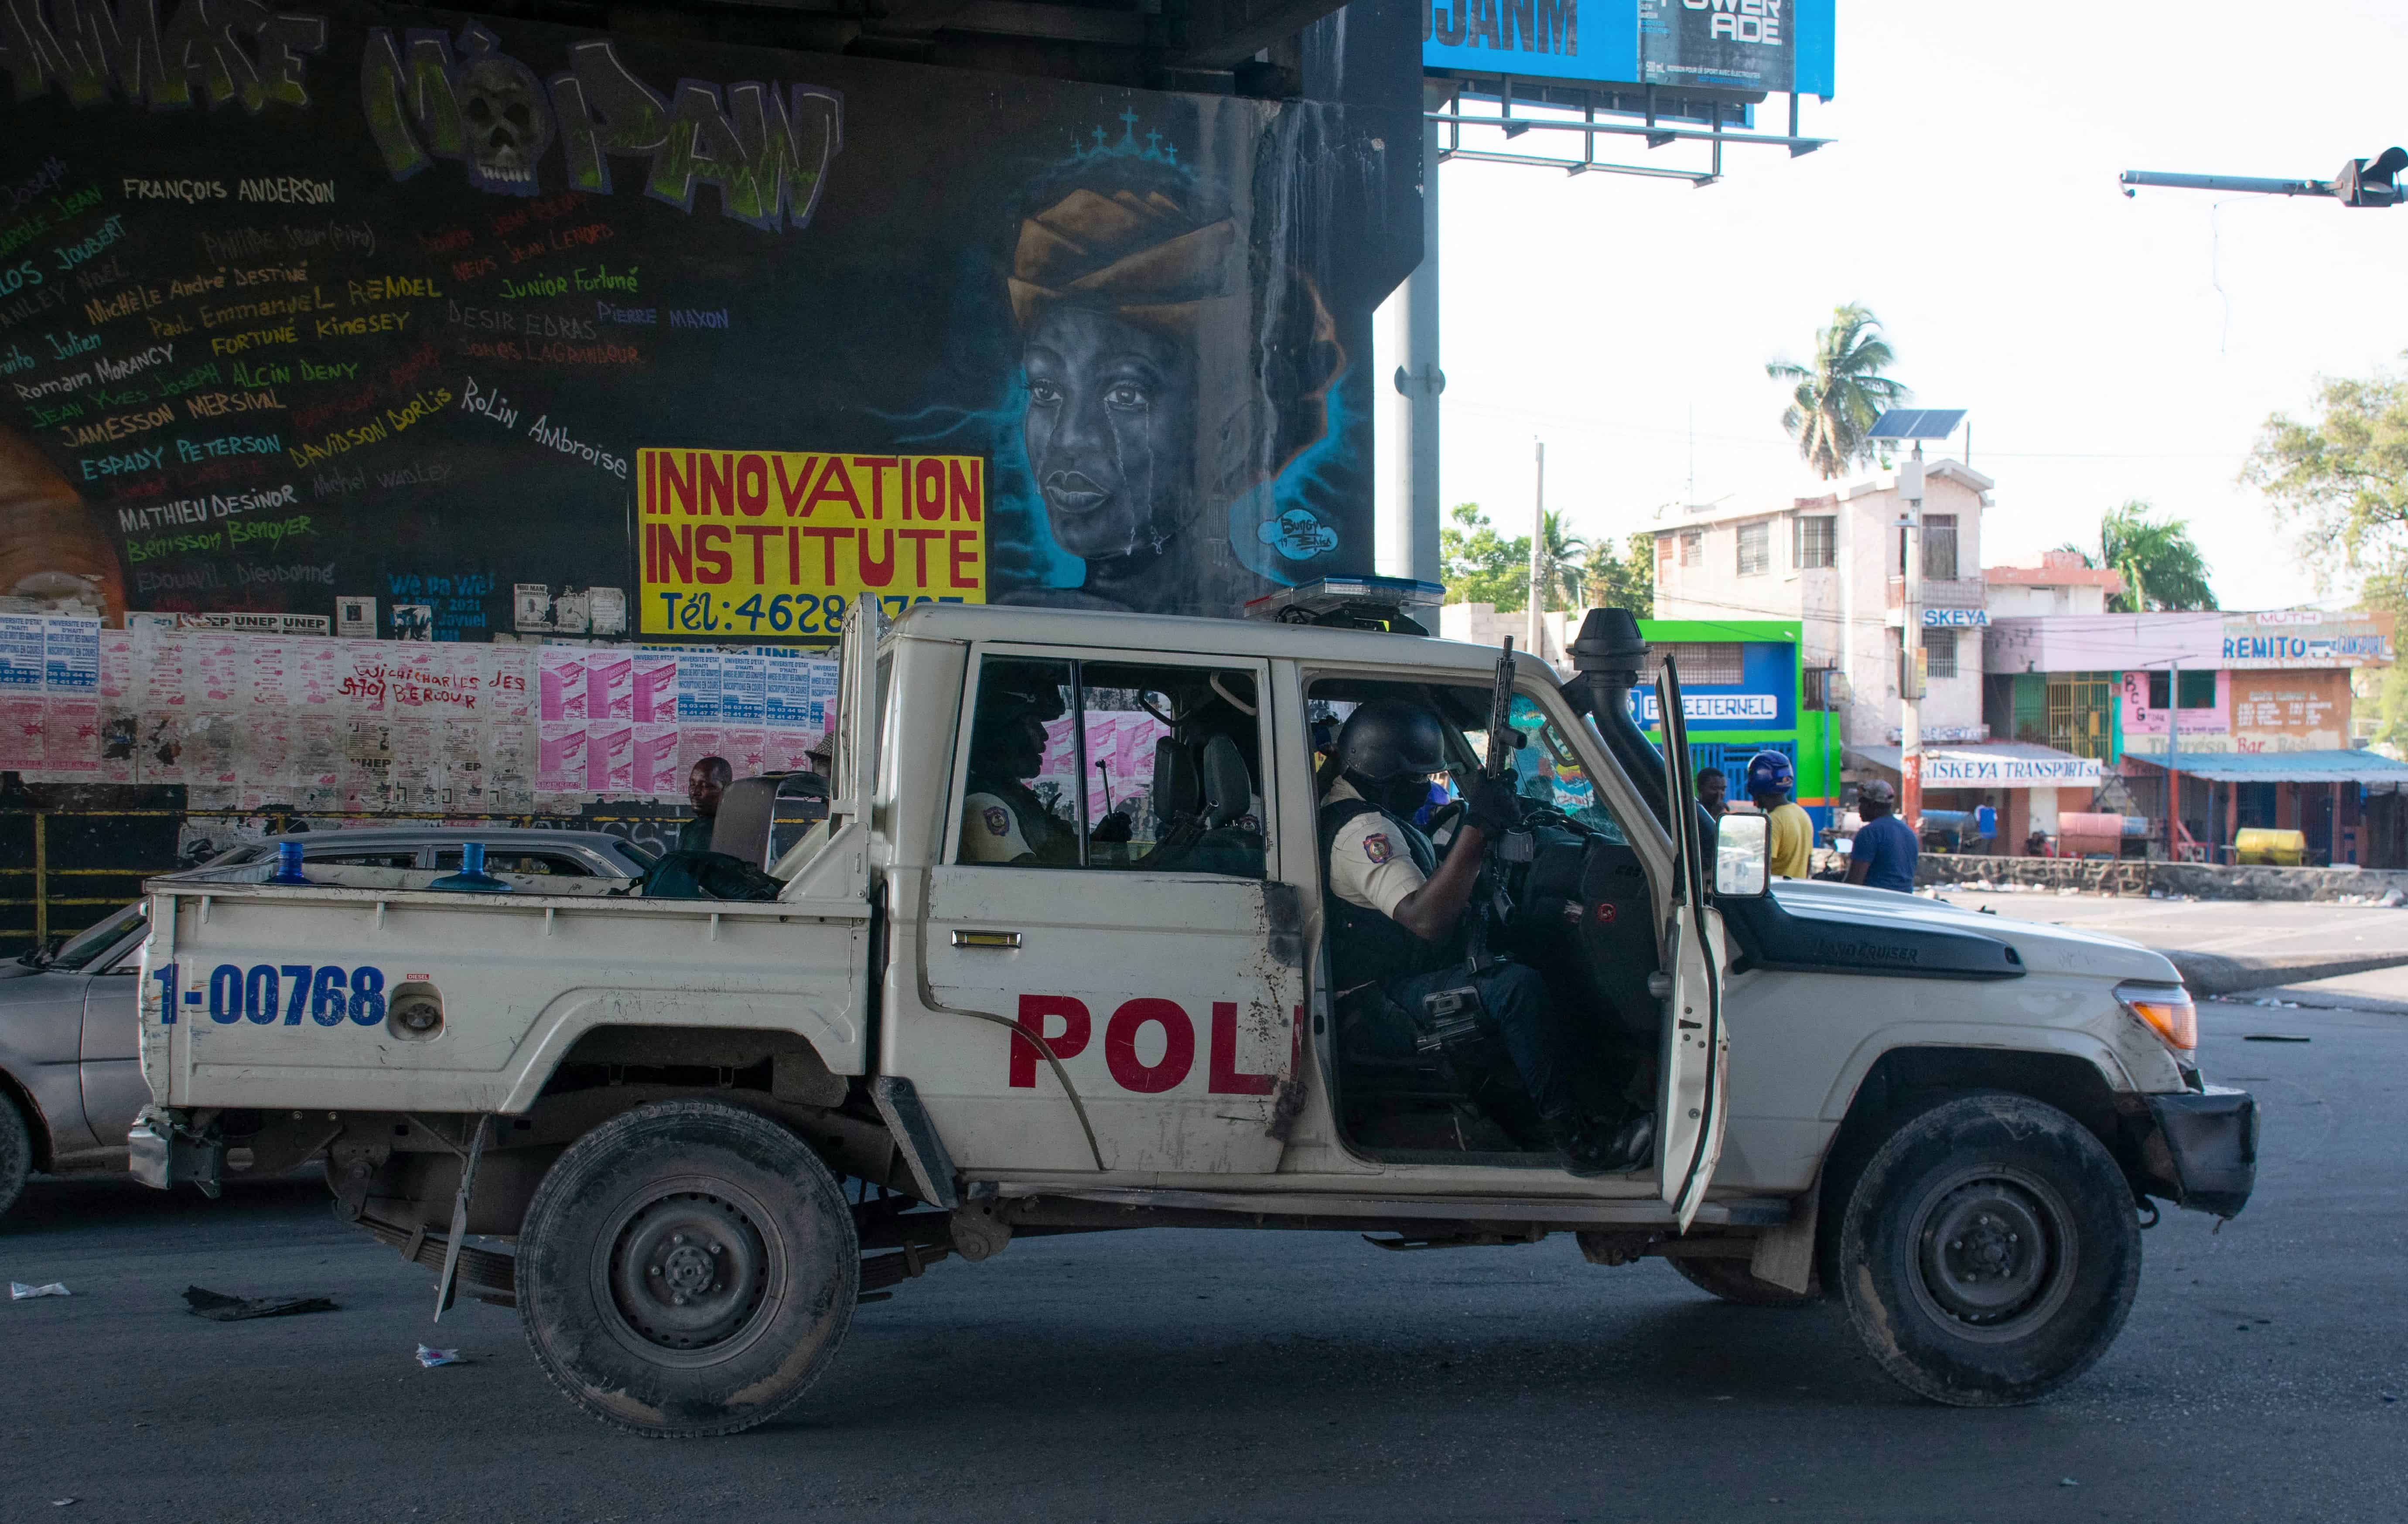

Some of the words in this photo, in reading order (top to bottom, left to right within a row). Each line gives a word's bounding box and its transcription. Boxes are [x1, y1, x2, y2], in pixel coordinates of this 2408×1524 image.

[1423, 0, 1577, 57] JANM
[1711, 13, 1782, 45] ADE
[123, 178, 227, 205] FRANÇOIS
[238, 175, 336, 205] ANDERSON
[53, 214, 126, 270] JOUBERT
[669, 307, 730, 330] MAXON
[60, 403, 175, 448] JAMESSON
[79, 445, 164, 481] ESPADY
[176, 433, 282, 464] PETERSON
[646, 451, 982, 522] INNOVATION
[118, 498, 208, 534] MATHIEU
[646, 524, 980, 588] INSTITUTE
[235, 617, 277, 627] UNEP
[283, 618, 326, 628] UNEP
[1924, 610, 1987, 625] SKEYA
[2222, 636, 2306, 658] REMITO
[489, 670, 525, 691] JES
[2004, 762, 2087, 778] TRANSPORT
[153, 963, 385, 1027] 1-00768
